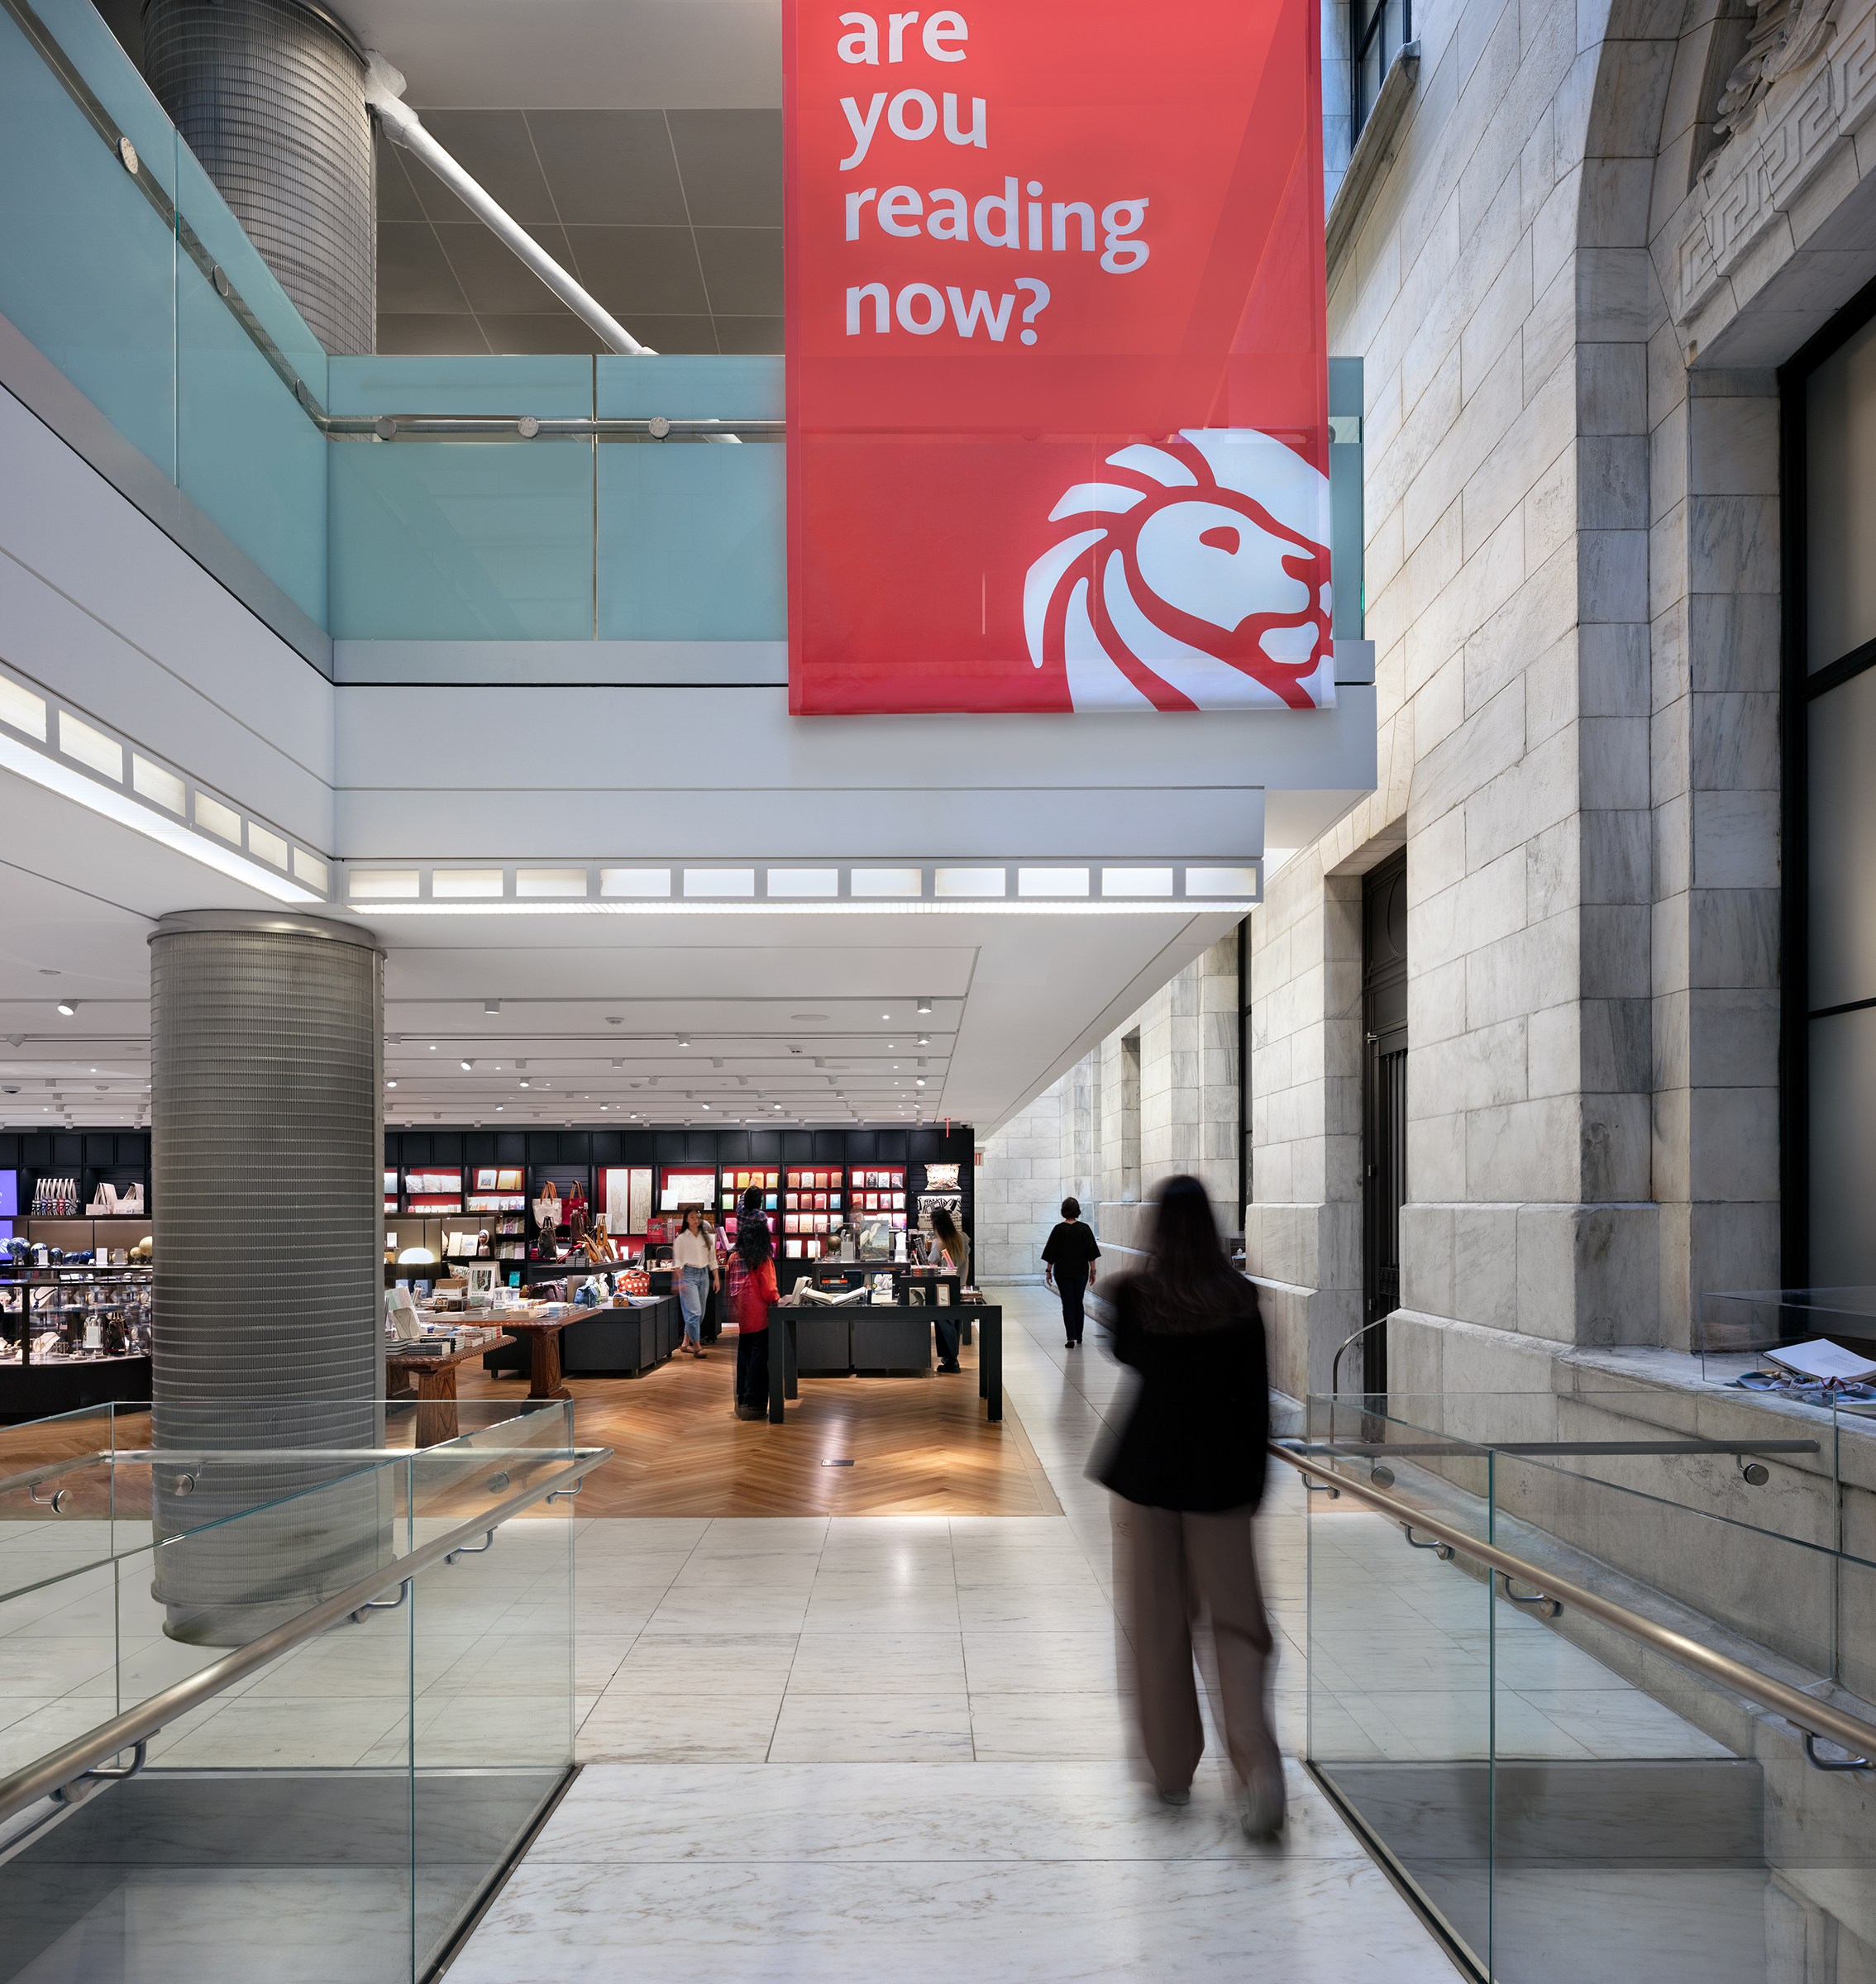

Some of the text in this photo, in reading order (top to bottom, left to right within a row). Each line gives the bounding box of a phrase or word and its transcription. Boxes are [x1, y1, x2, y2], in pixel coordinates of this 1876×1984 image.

[837, 10, 968, 65] are
[839, 88, 987, 170] you
[845, 175, 1150, 274] reading
[846, 277, 1051, 346] now?
